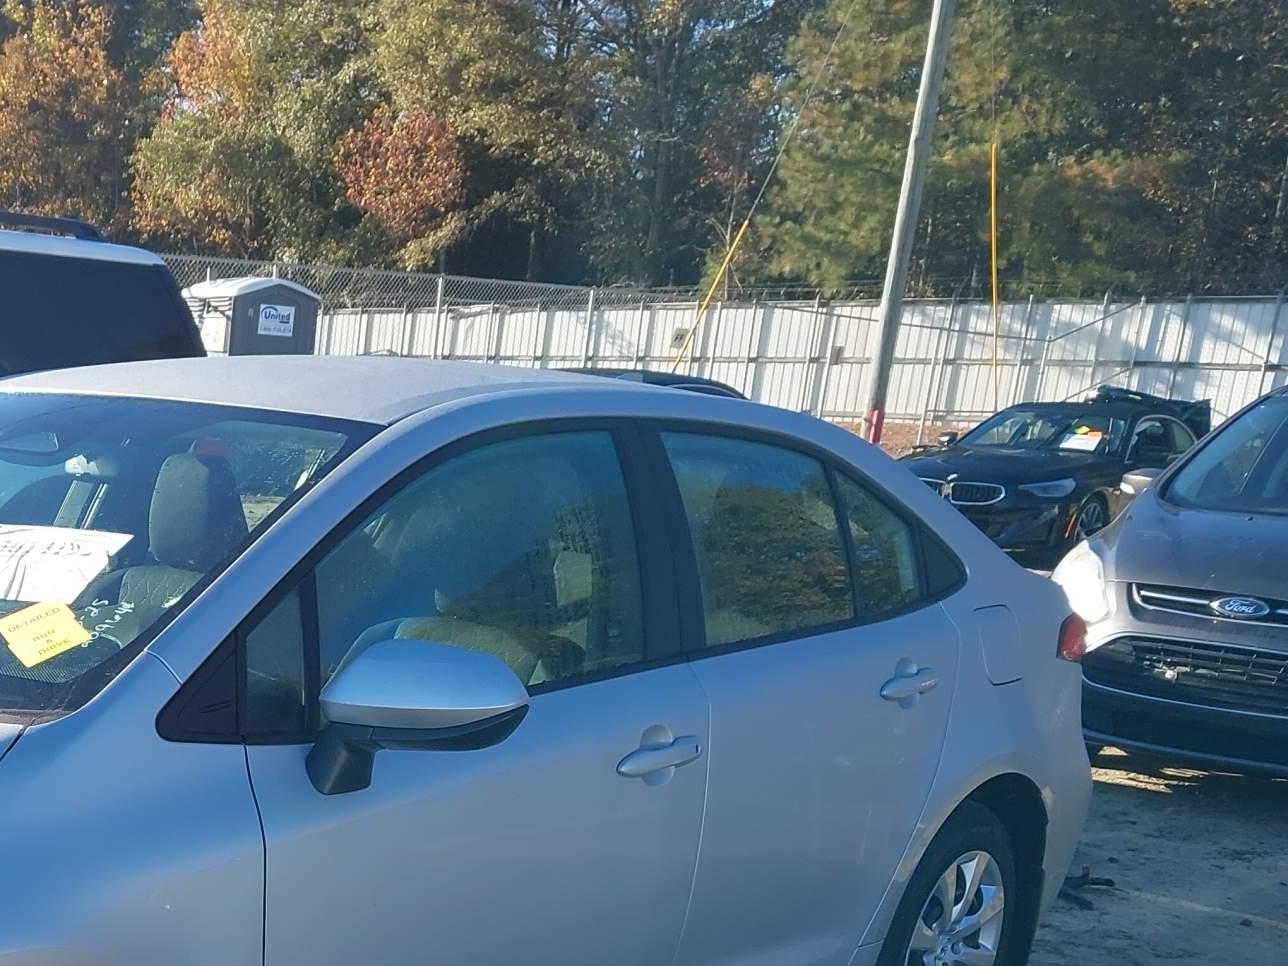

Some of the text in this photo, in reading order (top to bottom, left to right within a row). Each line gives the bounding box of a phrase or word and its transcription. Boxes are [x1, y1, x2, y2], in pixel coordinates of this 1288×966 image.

[264, 310, 291, 321] United
[1224, 599, 1257, 613] Ford
[7, 606, 61, 633] DETAILED
[38, 638, 71, 655] DRIVE
